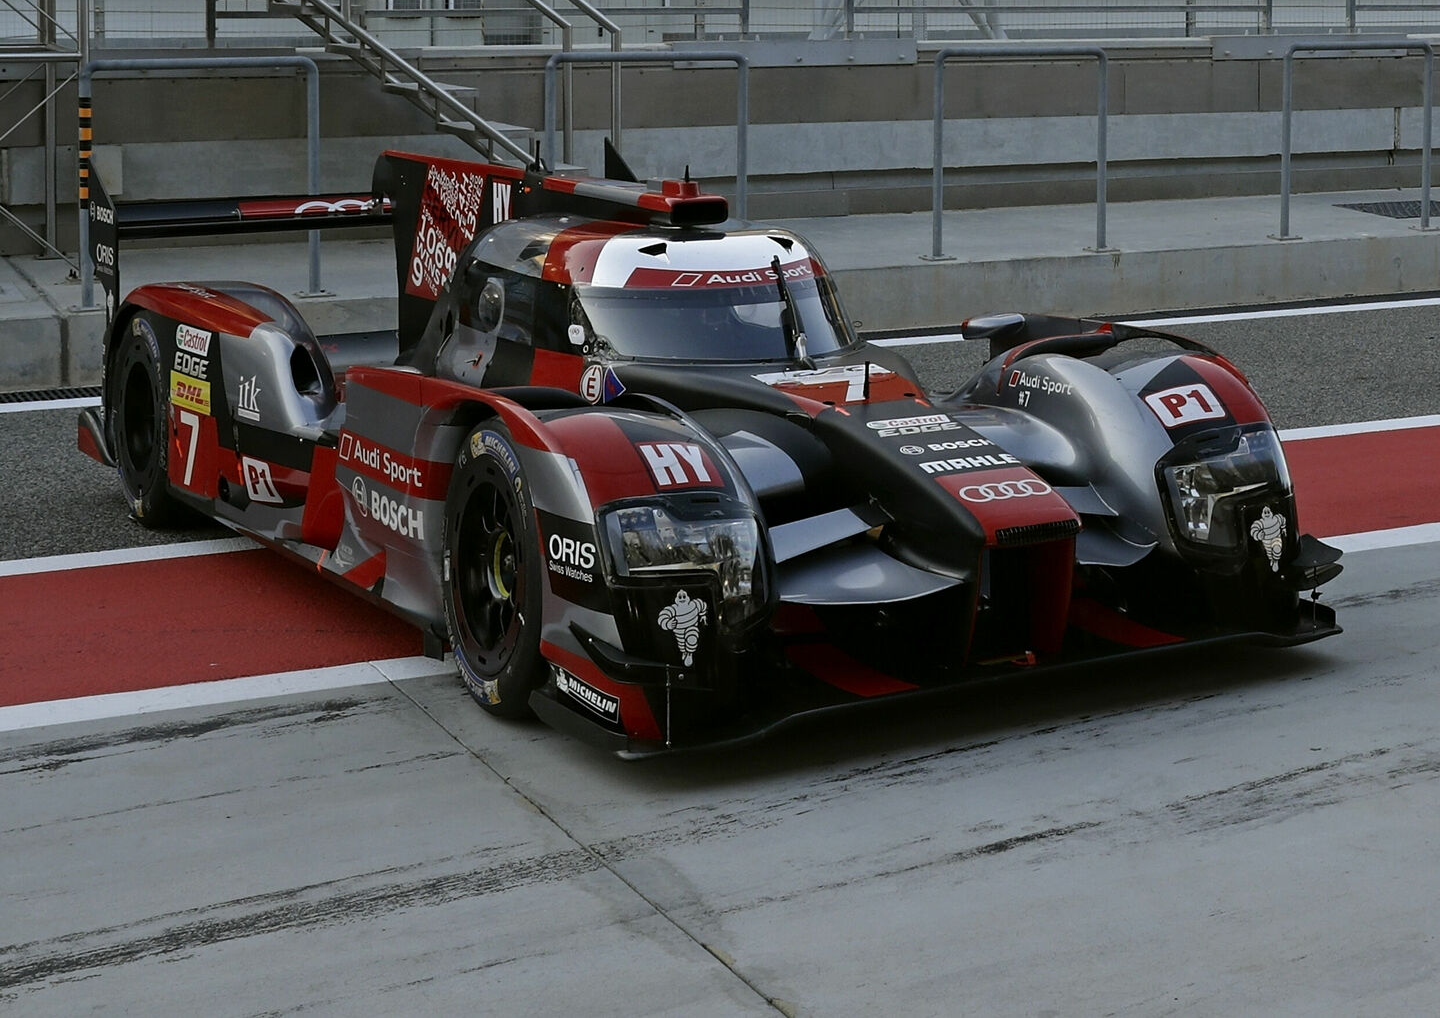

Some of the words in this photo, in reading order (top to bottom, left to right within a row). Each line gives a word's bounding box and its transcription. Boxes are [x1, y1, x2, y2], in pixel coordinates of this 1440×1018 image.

[96, 205, 114, 225] BOSCH
[493, 182, 511, 224] HY
[96, 243, 114, 266] ORIS
[411, 257, 424, 286] 9
[706, 269, 762, 285] Audi
[183, 329, 207, 353] Castrol
[174, 351, 210, 379] EDGE
[176, 381, 204, 405] DHL
[238, 375, 261, 412] itk
[1019, 371, 1040, 390] Audi
[1042, 377, 1073, 396] Sport
[1018, 391, 1031, 407] #7
[1158, 390, 1214, 420] P1
[877, 421, 962, 437] EDGE
[888, 415, 945, 428] Castrol
[181, 410, 199, 486] 7
[484, 435, 516, 474] MICHELIN
[928, 438, 996, 452] BOSCH
[354, 439, 380, 470] Audi
[383, 452, 422, 487] Sport
[639, 442, 712, 487] HY
[918, 453, 1022, 474] MAHLE
[249, 460, 278, 501] P1
[371, 489, 425, 541] BOSCH
[549, 533, 596, 569] ORIS
[548, 559, 564, 574] Swiss
[565, 563, 593, 583] Watches
[568, 674, 617, 714] MICHELIN
